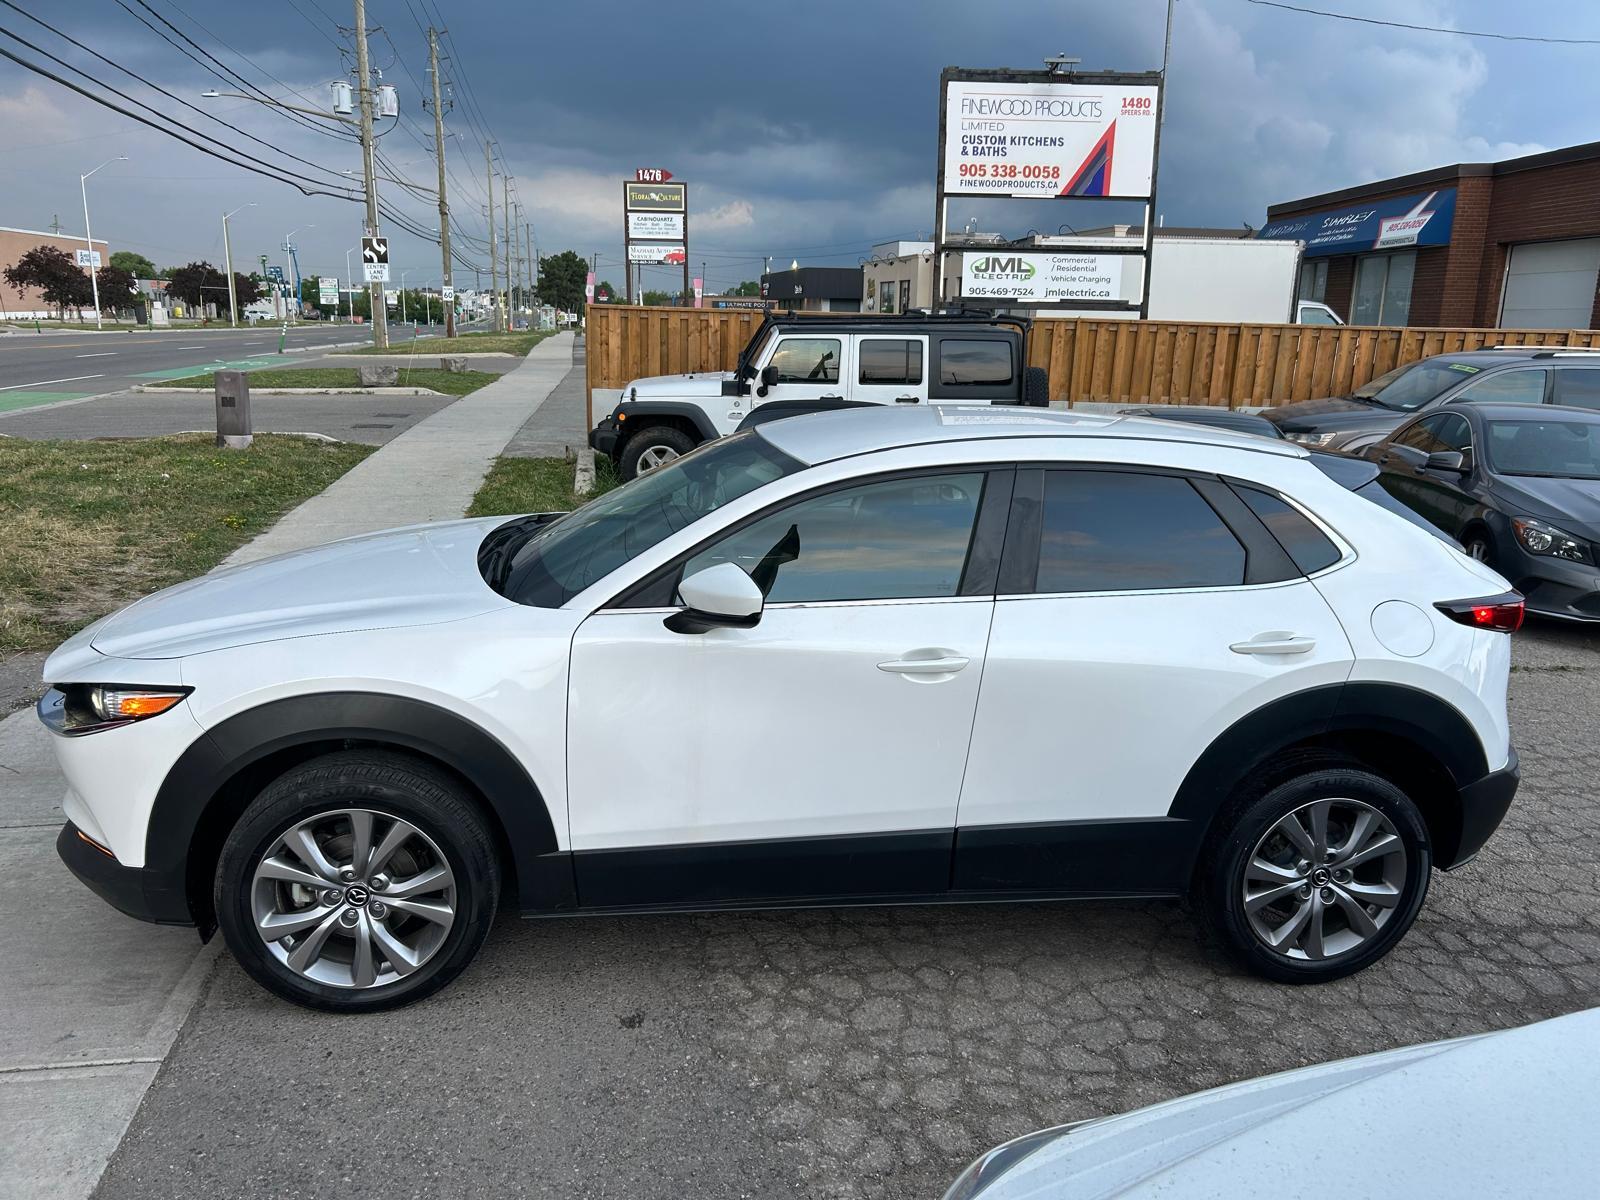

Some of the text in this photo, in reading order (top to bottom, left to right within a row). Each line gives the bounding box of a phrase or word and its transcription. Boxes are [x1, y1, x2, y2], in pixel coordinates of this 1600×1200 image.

[961, 98, 1103, 117] FINEWOOD PRODUCTS
[1121, 97, 1151, 109] 1480
[961, 121, 1005, 131] LIMITED
[961, 134, 1065, 147] CUSTOM KITCHENS
[960, 145, 1007, 157] & BATHS
[638, 169, 662, 181] 1476
[959, 163, 1060, 179] 905 338-0058
[959, 179, 1059, 189] FINEWOODPRODUCTS.CA
[974, 256, 1031, 273] JML
[1051, 256, 1097, 264] Commercial
[1077, 275, 1111, 284] Charging
[443, 291, 453, 299] 60
[968, 287, 1034, 296] 905-469-7524
[1044, 287, 1110, 298] jmlelectric.ca
